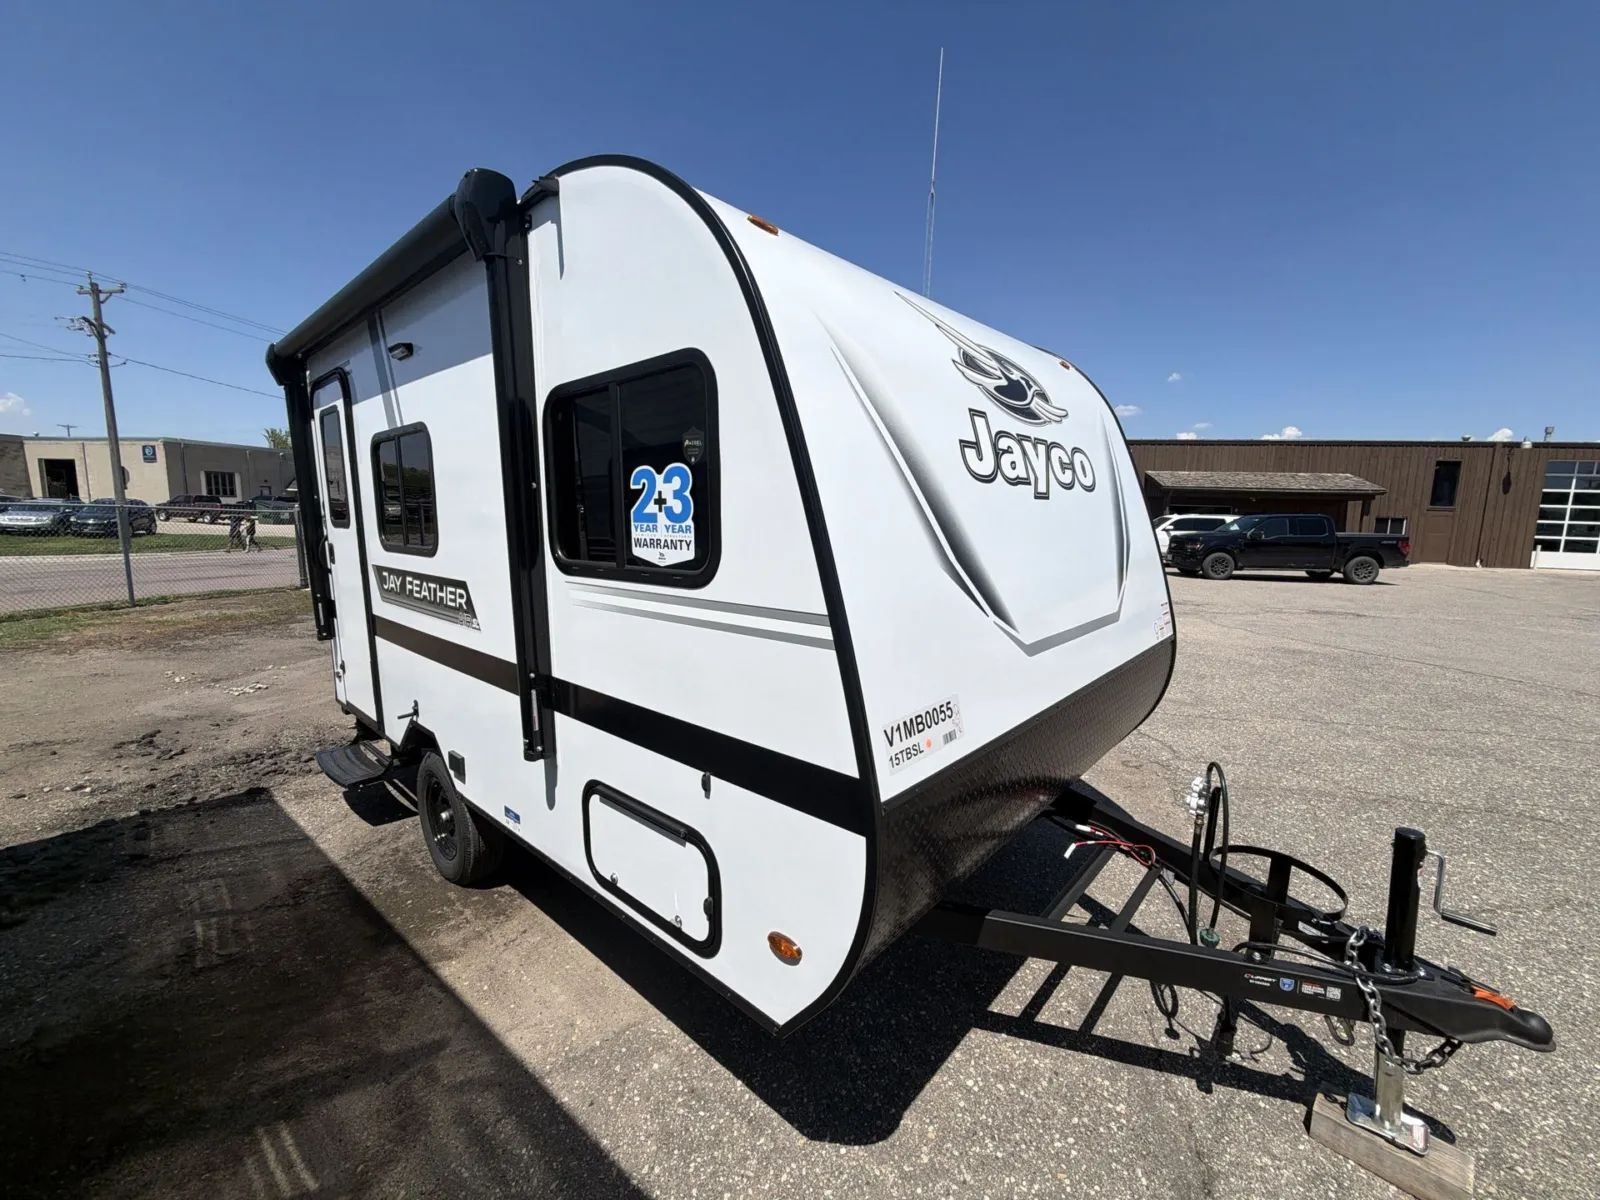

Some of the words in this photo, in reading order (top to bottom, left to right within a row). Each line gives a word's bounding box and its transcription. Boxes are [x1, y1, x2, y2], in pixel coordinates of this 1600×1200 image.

[959, 408, 1096, 500] Jayco
[633, 524, 658, 533] YEAR
[664, 525, 692, 534] YEAR
[633, 537, 692, 551] WARRANTY
[382, 571, 402, 592] JAY
[406, 576, 467, 610] FEATHER
[883, 701, 954, 748] V1MB0055
[889, 742, 925, 769] 15TBSL
